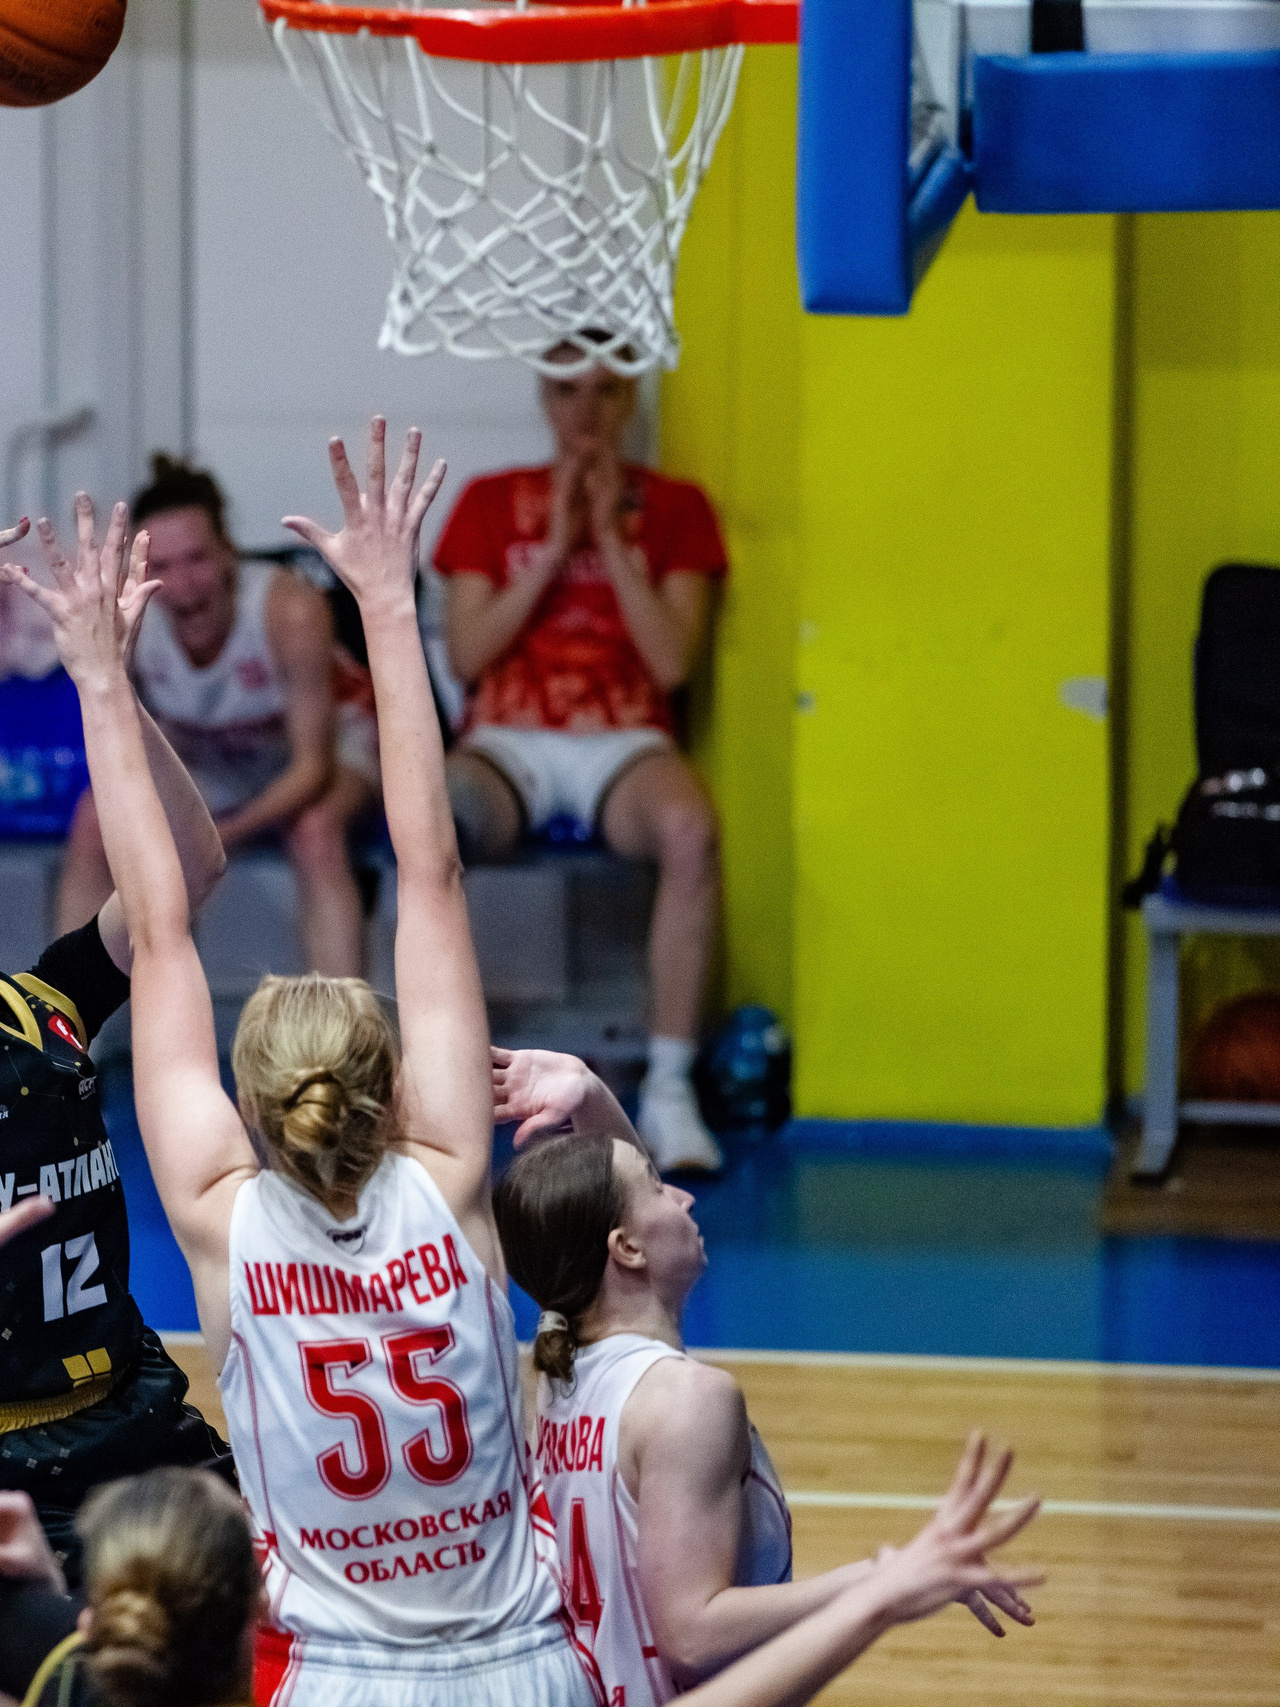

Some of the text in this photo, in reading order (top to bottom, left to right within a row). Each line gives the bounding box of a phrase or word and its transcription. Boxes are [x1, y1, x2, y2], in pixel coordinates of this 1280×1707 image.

[40, 1231, 108, 1322] 12
[244, 1233, 468, 1316] ШИШМАРЕВА
[297, 1321, 473, 1501] 55
[299, 1490, 512, 1551] МОСКОВСКАЯ
[344, 1539, 486, 1584] ОБЛАСТЬ
